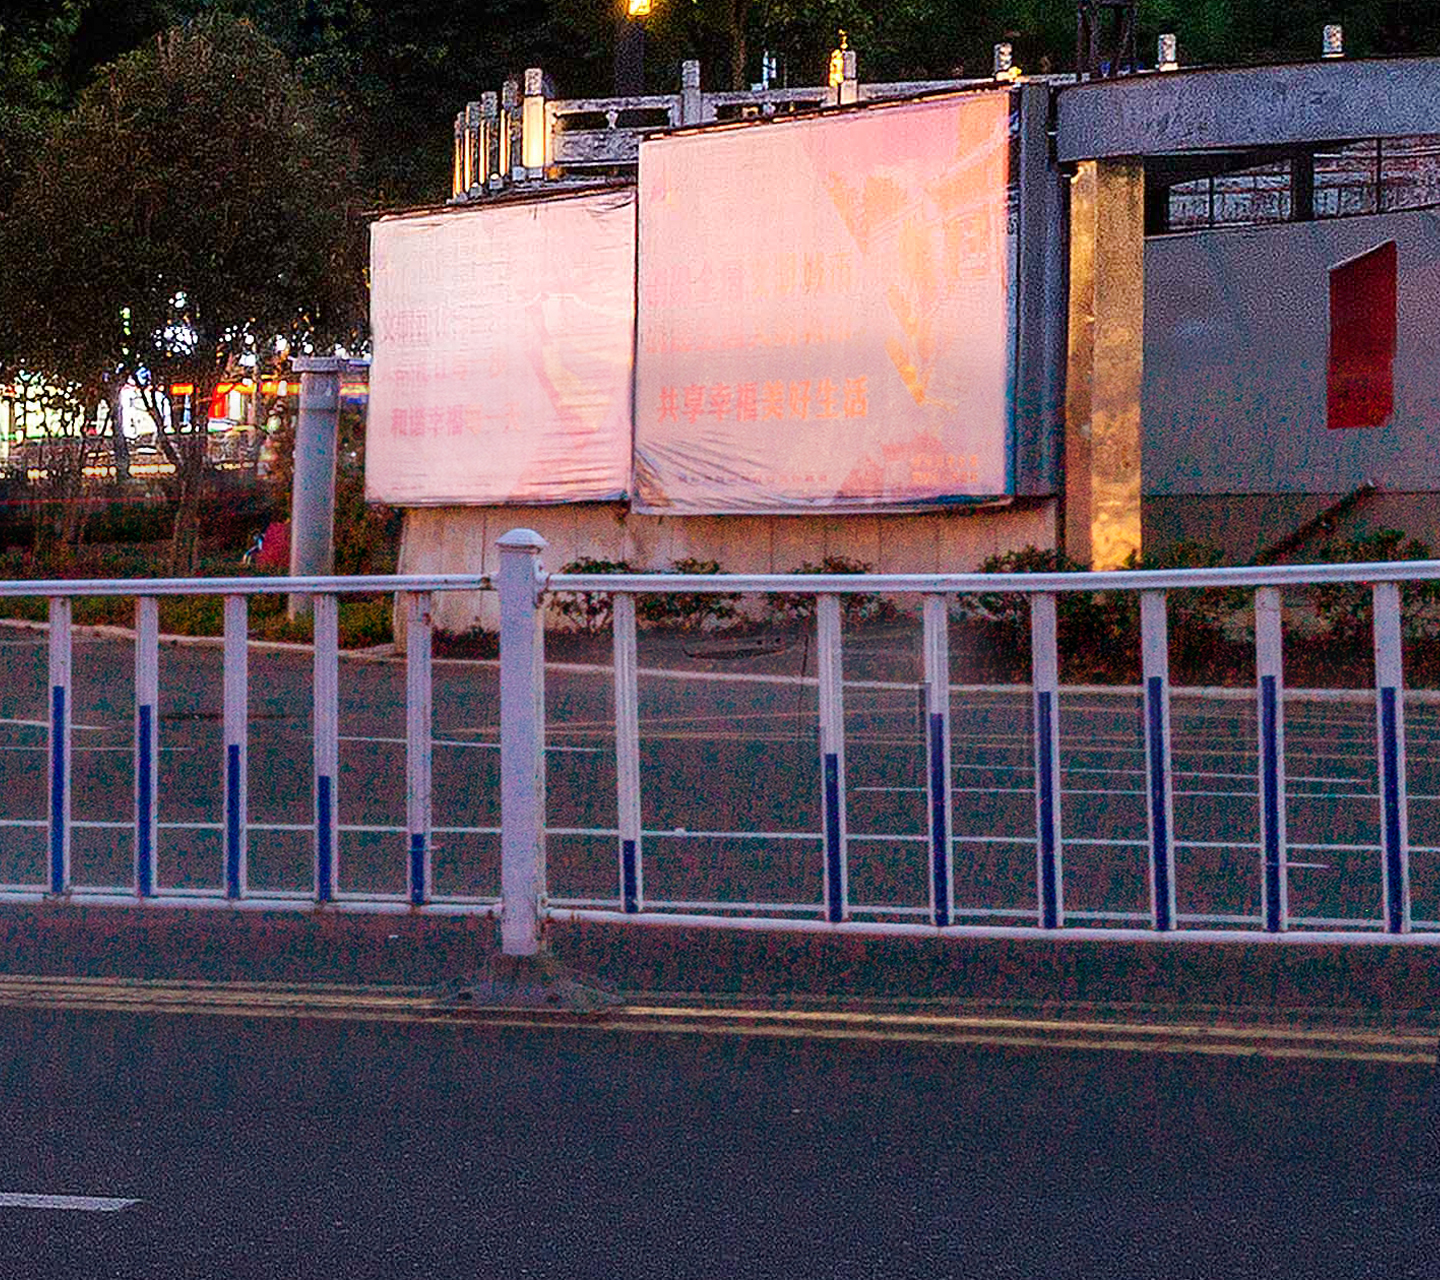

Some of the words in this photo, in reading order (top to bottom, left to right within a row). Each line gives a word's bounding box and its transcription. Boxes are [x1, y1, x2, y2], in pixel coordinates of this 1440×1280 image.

[657, 376, 870, 424] 共享幸福美好生活
